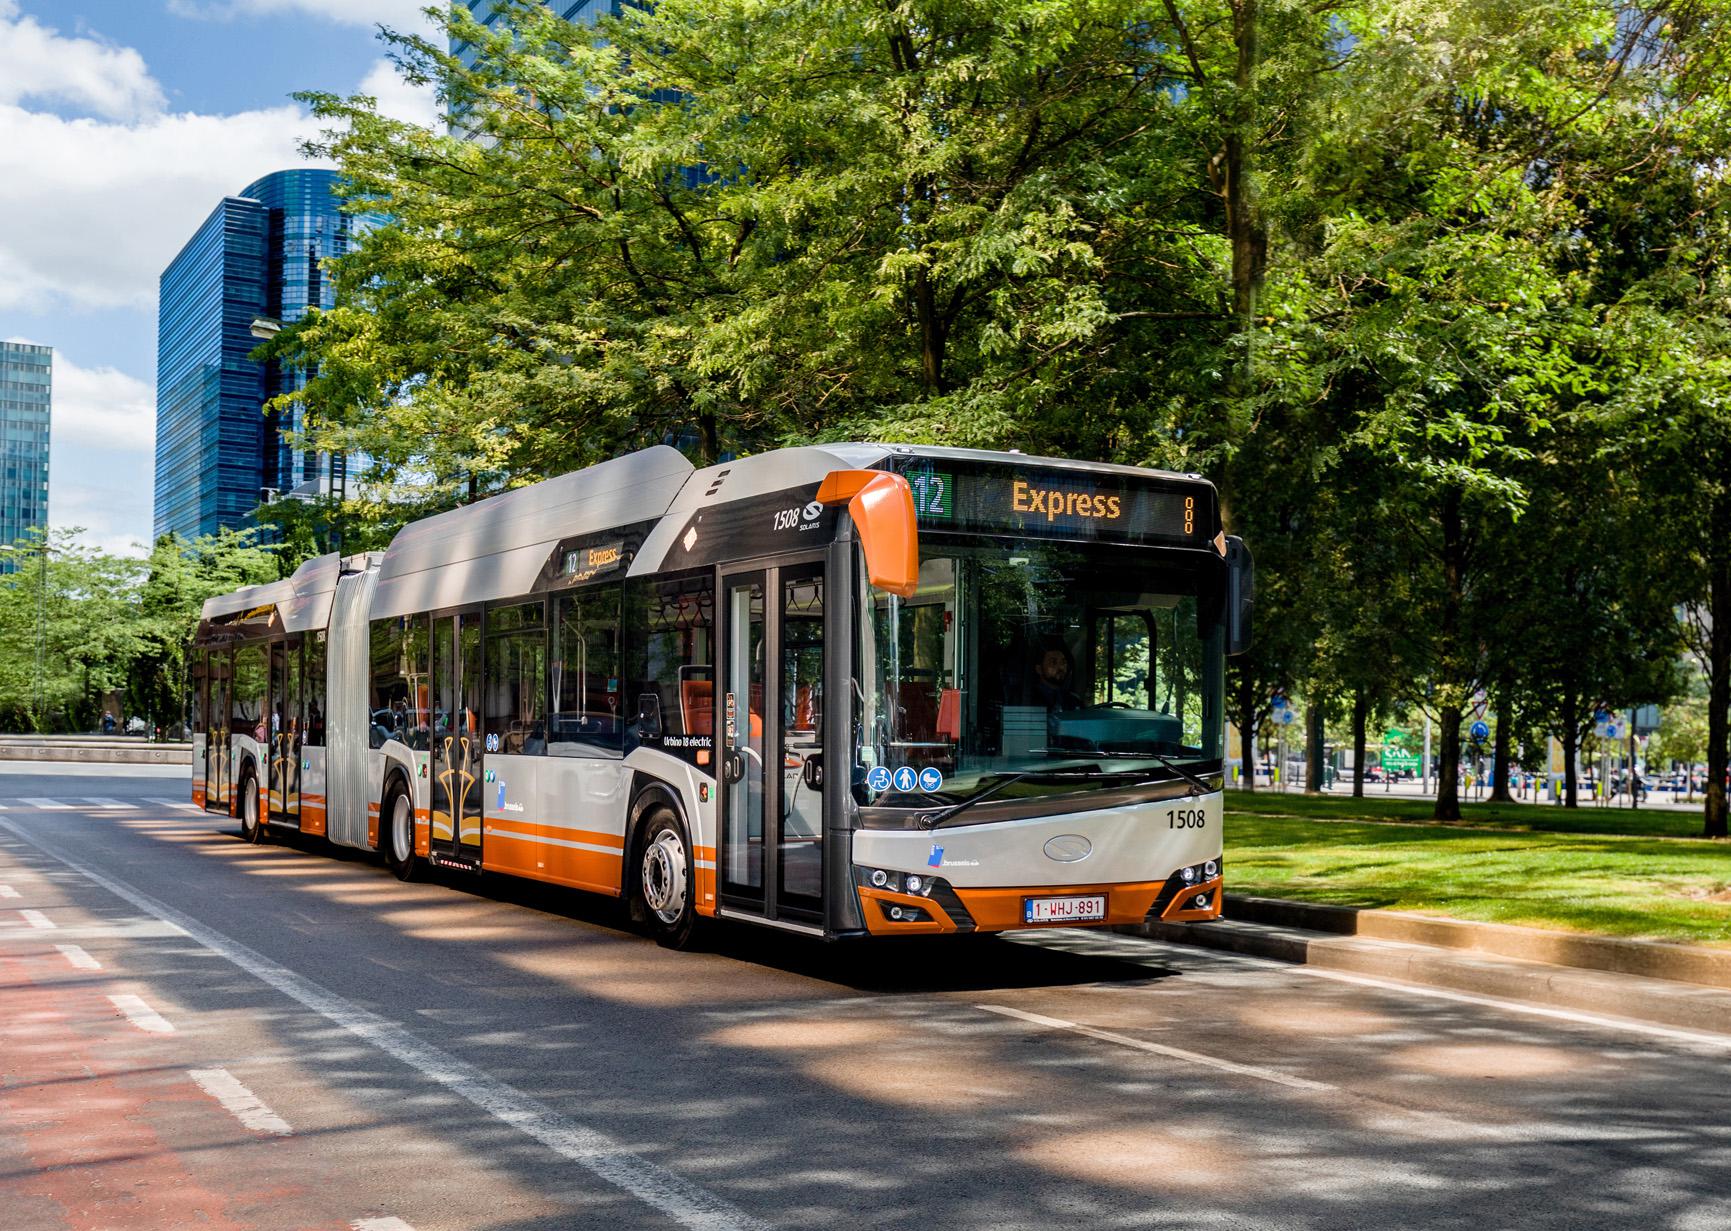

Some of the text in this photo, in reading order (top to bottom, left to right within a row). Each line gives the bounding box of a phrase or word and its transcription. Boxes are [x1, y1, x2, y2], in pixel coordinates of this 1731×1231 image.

[914, 476, 1121, 521] 12 Express
[774, 507, 801, 531] 1508
[568, 548, 617, 574] 12 Express
[664, 736, 682, 747] Urbino
[690, 736, 712, 747] electric
[1166, 809, 1206, 829] 1508
[1035, 900, 1100, 917] 1-WHJ-891
